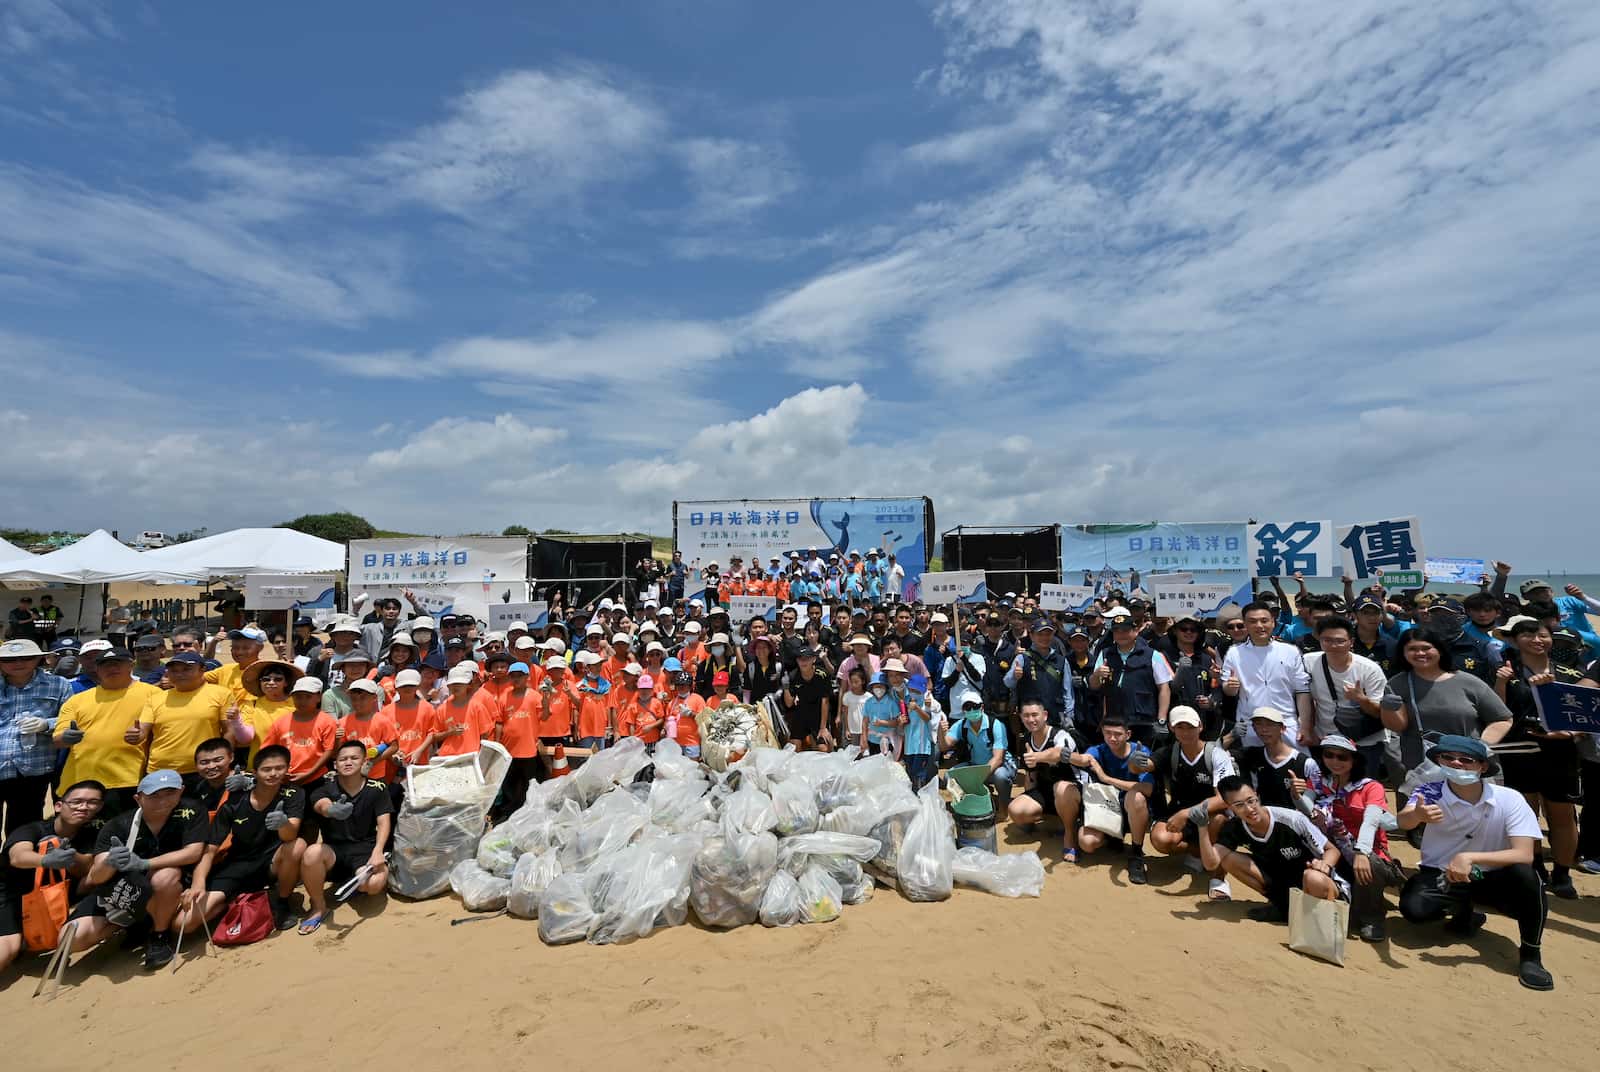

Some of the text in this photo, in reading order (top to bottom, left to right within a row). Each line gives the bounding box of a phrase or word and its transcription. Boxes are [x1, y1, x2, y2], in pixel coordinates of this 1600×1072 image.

[690, 509, 799, 526] 日月光海洋日
[1129, 535, 1240, 551] 日月光海洋日
[1254, 520, 1321, 577] 銘
[1341, 520, 1417, 579] 傳
[364, 550, 467, 567] 日月光海洋日
[1158, 591, 1217, 600] 警察專科學校
